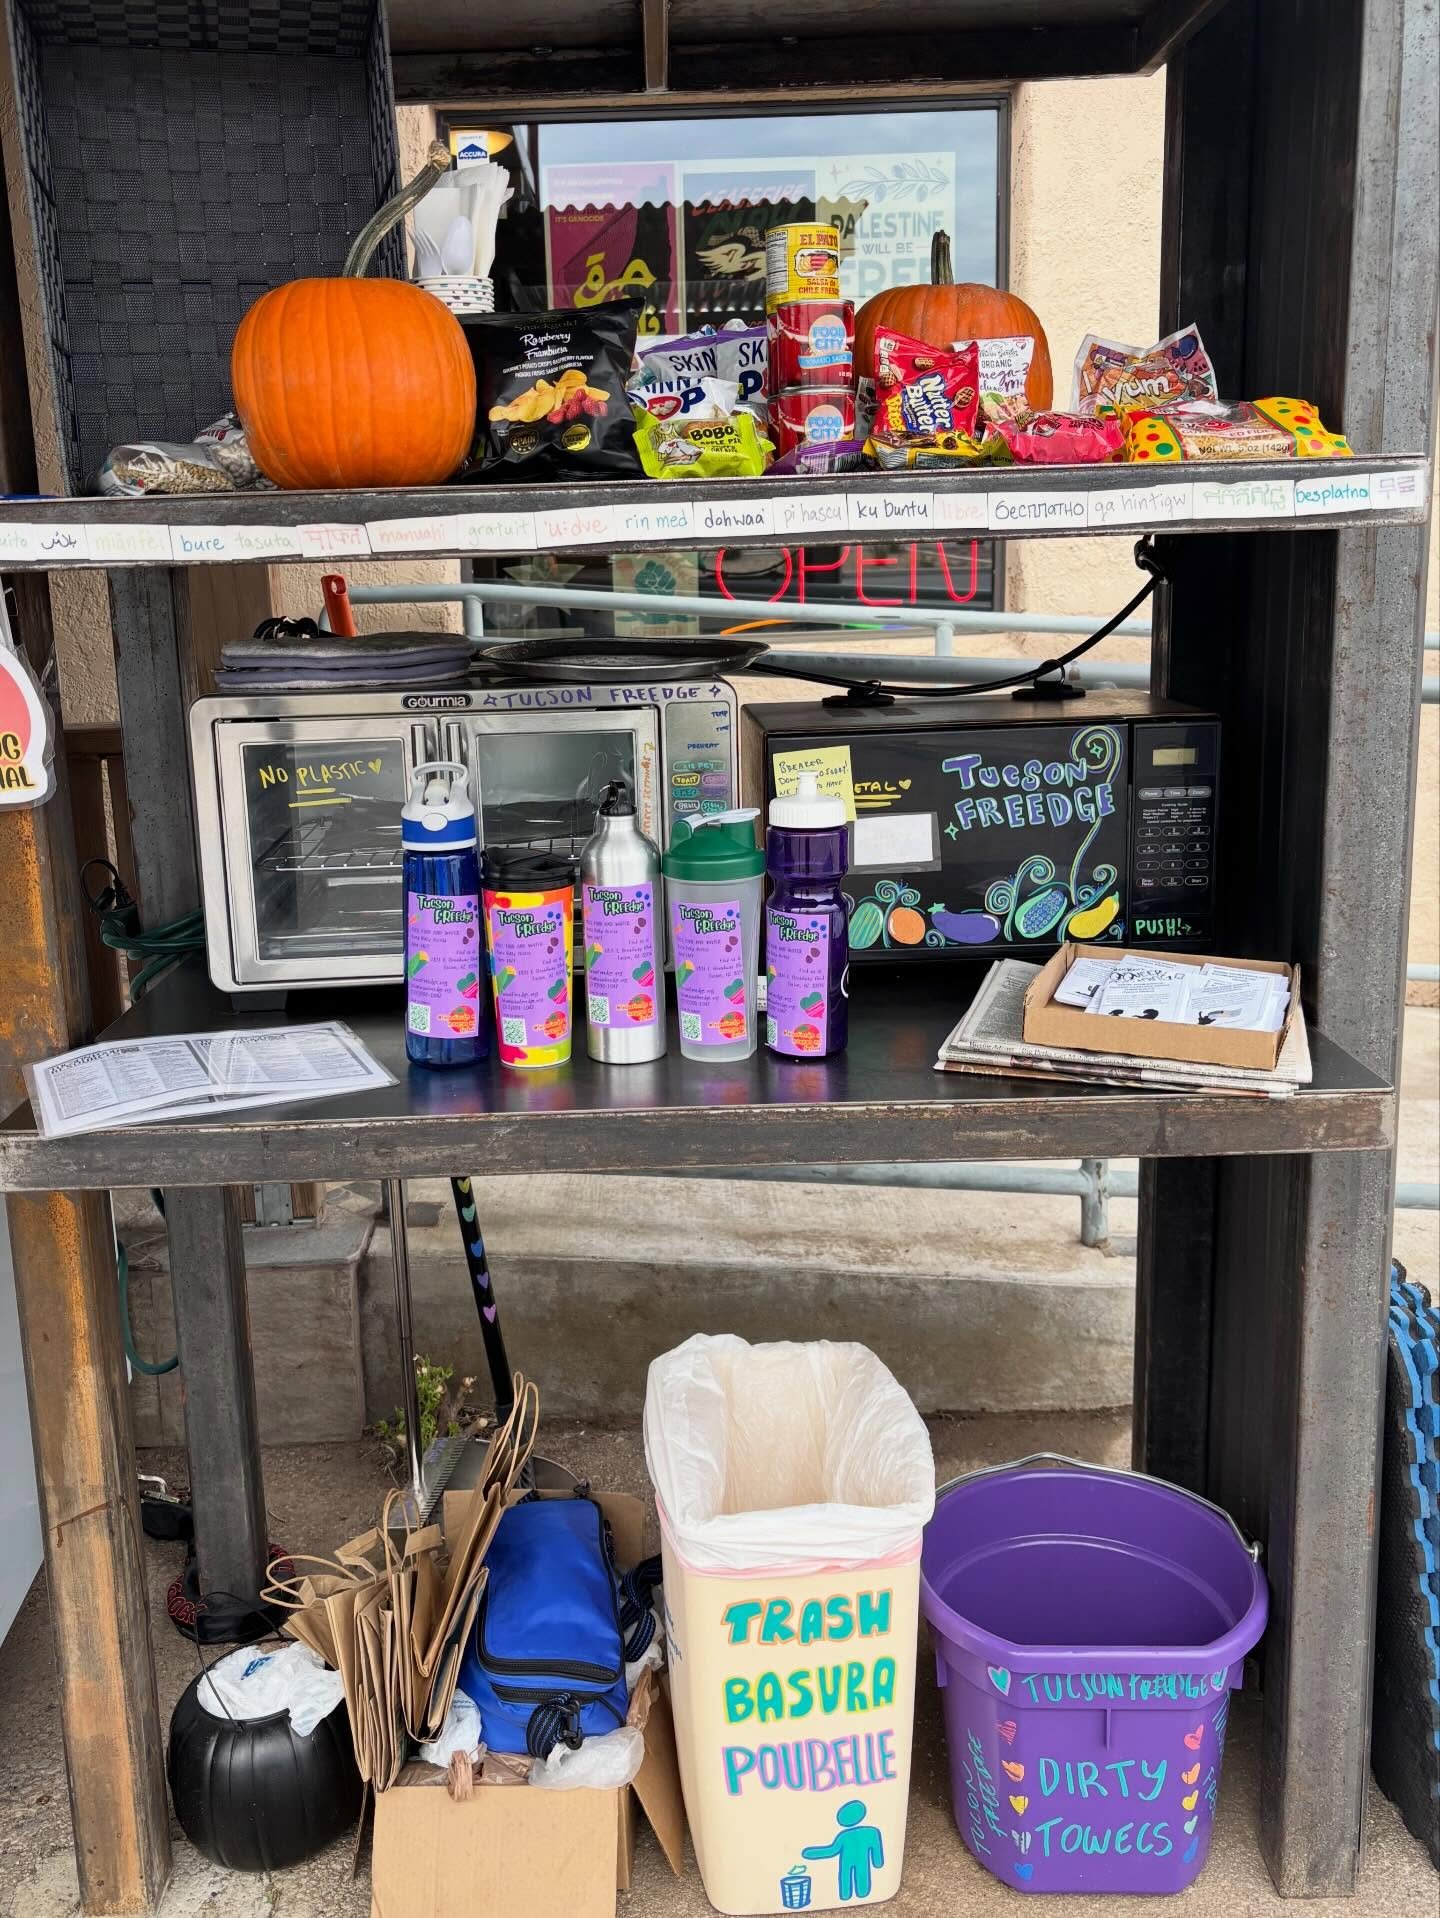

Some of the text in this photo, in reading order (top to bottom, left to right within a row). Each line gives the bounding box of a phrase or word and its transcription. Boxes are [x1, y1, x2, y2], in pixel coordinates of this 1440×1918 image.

[831, 211, 944, 240] PALESTINE
[800, 234, 815, 246] EL
[862, 242, 912, 255] WILL BE
[799, 286, 820, 294] CHILE
[807, 278, 829, 286] SALSA
[520, 332, 571, 347] Raspberry
[812, 325, 845, 337] FOOD
[524, 344, 568, 360] Frambuesa
[815, 337, 843, 350] CITY
[806, 354, 850, 366] TOMATO SAUCE
[981, 359, 1012, 369] ORGANIC
[979, 362, 1030, 386] mega-3
[905, 384, 935, 432] Butter
[919, 374, 952, 428] Nutter
[807, 415, 842, 427] FOOD
[810, 428, 841, 441] CITY
[1237, 444, 1244, 453] 5
[1247, 444, 1260, 452] oz
[1295, 484, 1369, 507] besplatno
[783, 504, 796, 528] pi
[857, 500, 928, 518] ku buntu
[994, 500, 1085, 520] бесплатно
[625, 509, 688, 530] rin med
[0, 531, 28, 547] uito
[467, 518, 529, 546] gratuit
[180, 535, 225, 552] bure
[238, 533, 293, 549] tasuta
[716, 542, 978, 605] OPEN
[501, 686, 701, 708] TUCSON FREEDGE
[711, 710, 728, 718] TEMP
[259, 760, 366, 789] NO PLASTIC
[778, 758, 824, 774] BREAKER
[676, 775, 697, 784] TOAST
[854, 780, 896, 794] ETAL
[954, 782, 1116, 830] FREEDGE
[417, 894, 455, 911] Tucson
[588, 886, 623, 903] Tucson
[497, 910, 535, 926] Tucson
[679, 904, 714, 920] Tucson
[768, 909, 797, 928] Tucson
[1135, 917, 1182, 937] PUSH!
[720, 1586, 893, 1647] TRASH
[722, 1655, 898, 1726] BASURA
[1021, 1672, 1125, 1703] TUCSON
[721, 1728, 897, 1796] POUBELLE
[1038, 1756, 1168, 1802] DIRTY
